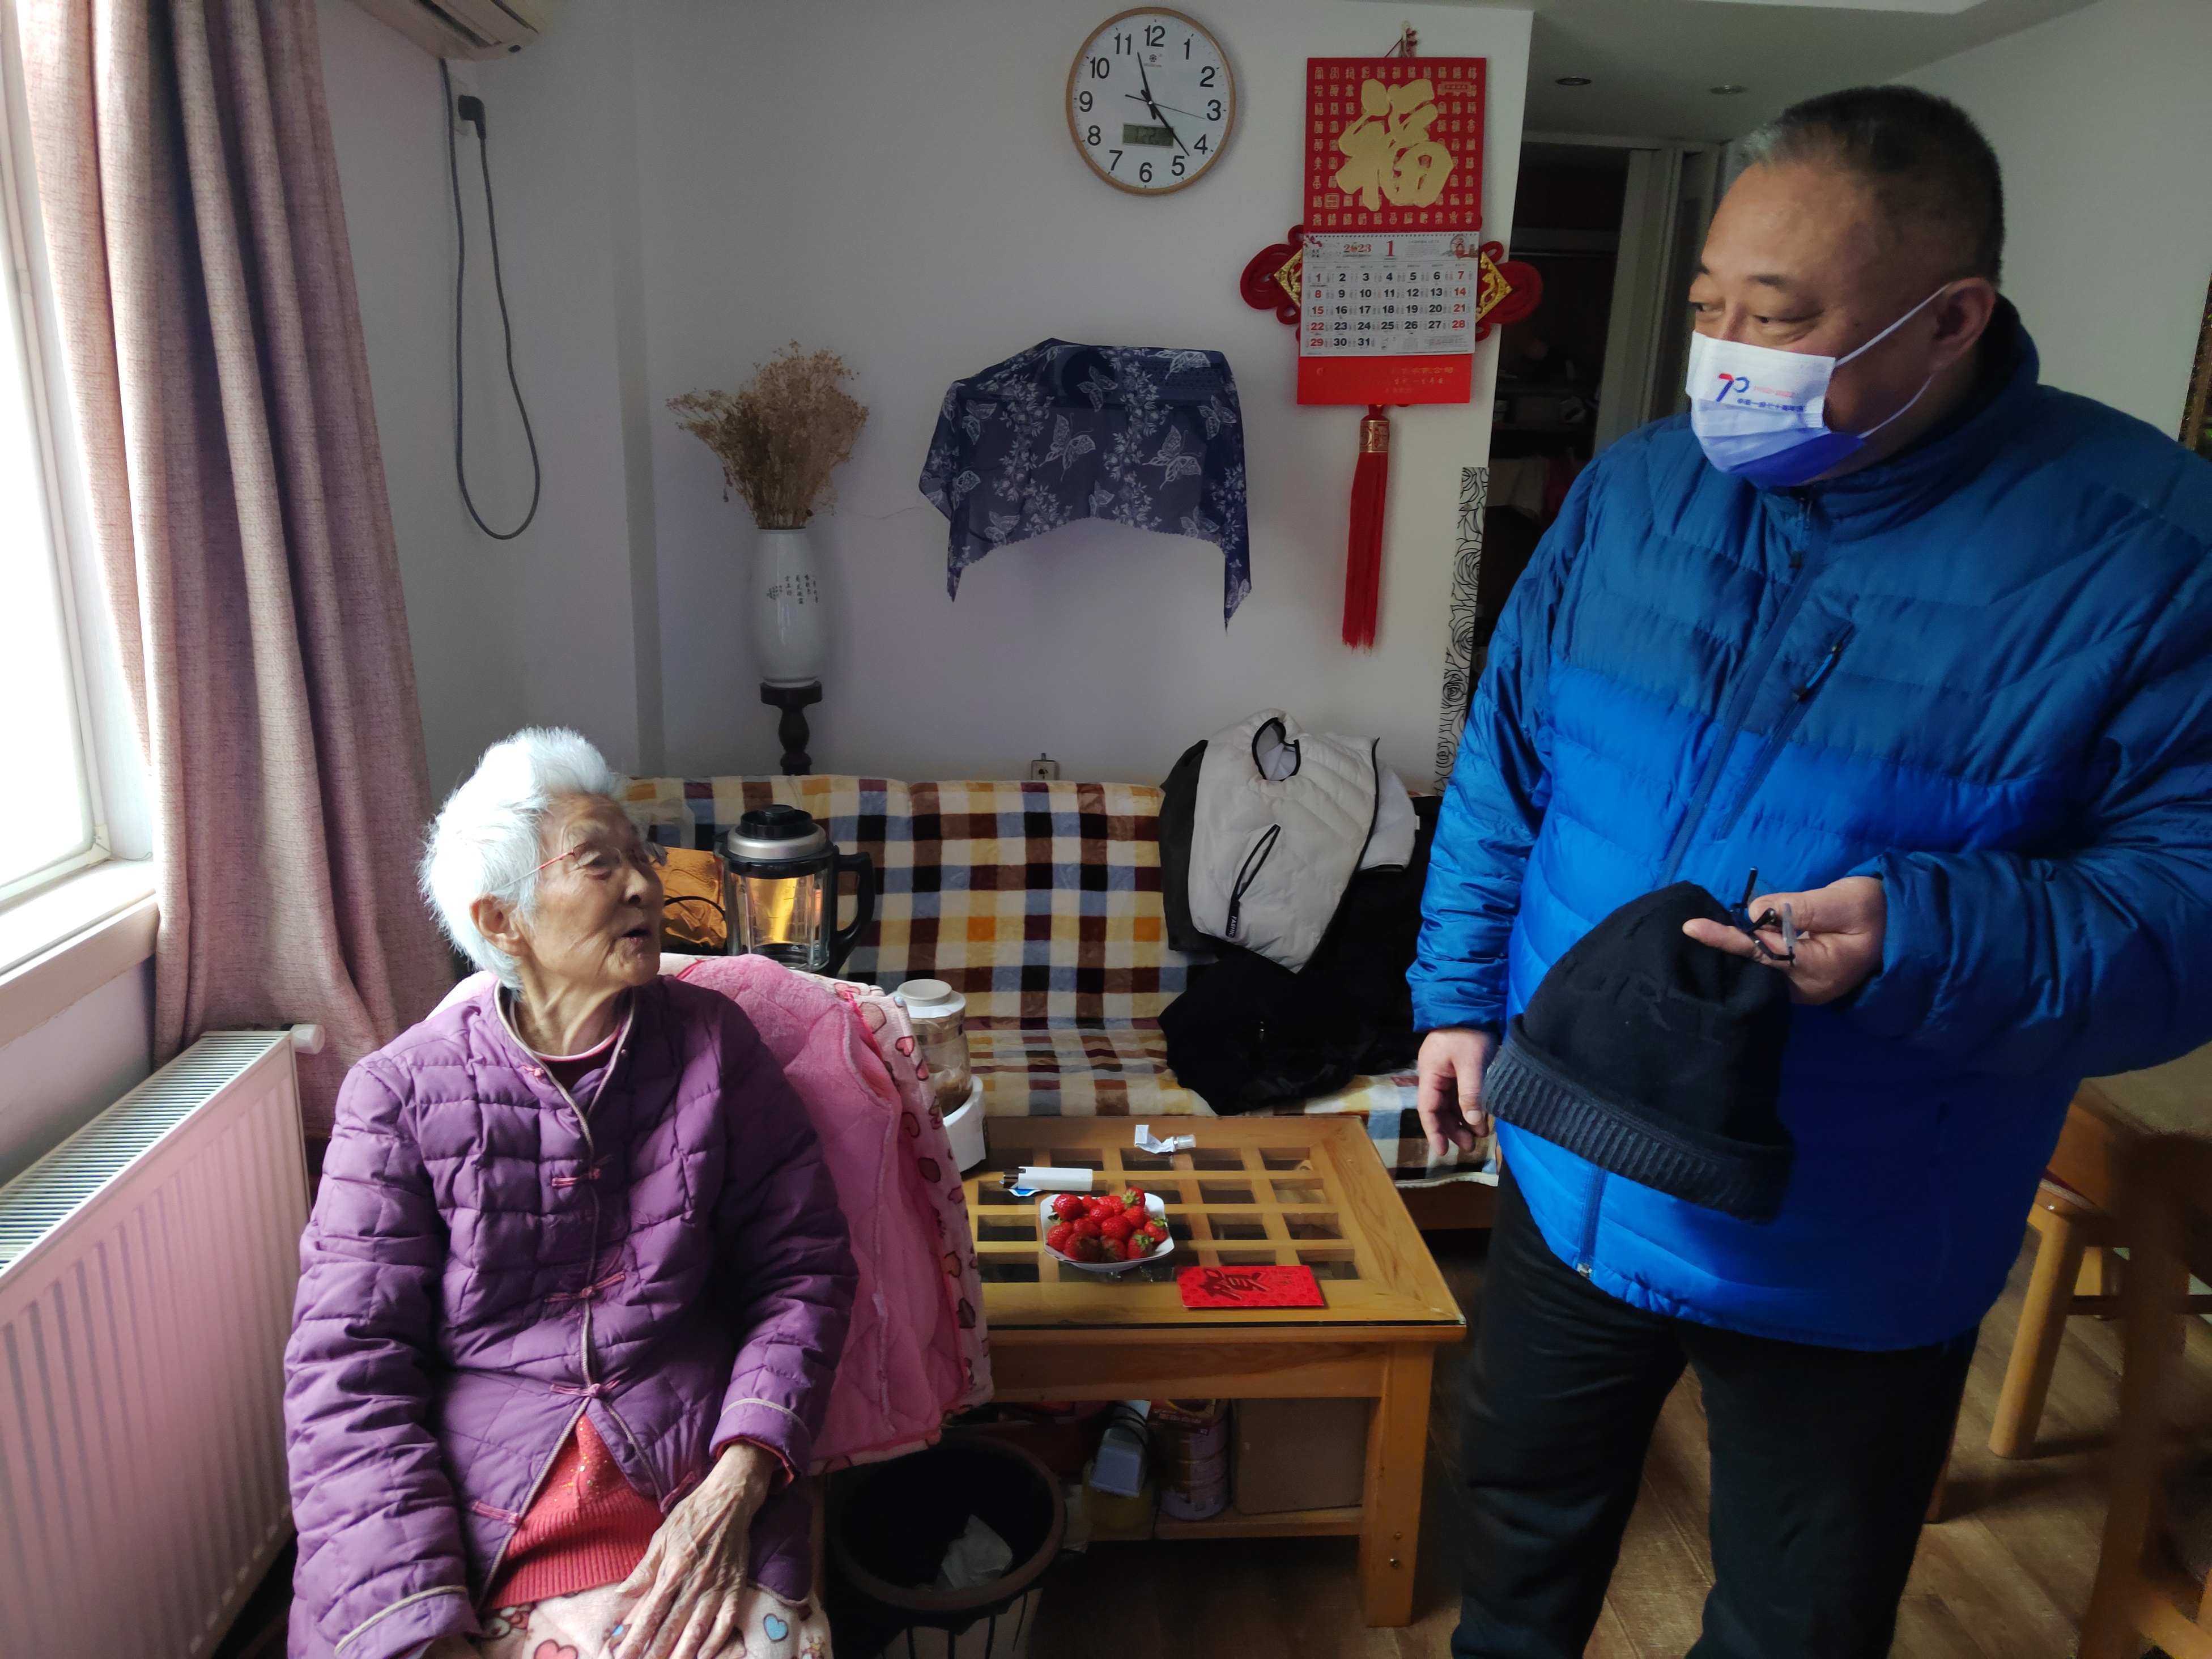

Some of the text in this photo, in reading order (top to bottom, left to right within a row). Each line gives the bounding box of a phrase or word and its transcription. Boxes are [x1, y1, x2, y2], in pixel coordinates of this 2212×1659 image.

[1114, 33, 1131, 55] 11
[1145, 25, 1165, 47] 12
[1184, 39, 1190, 59] 1
[1090, 57, 1109, 79] 10
[1200, 66, 1215, 87] 2
[1079, 91, 1092, 112] 9
[1207, 100, 1221, 121] 3
[1087, 125, 1101, 146] 8
[1194, 134, 1208, 155] 4
[1335, 78, 1453, 211] 福
[1109, 150, 1122, 171] 7
[1172, 156, 1185, 176] 5
[1139, 162, 1152, 182] 6
[1342, 243, 1372, 253] 2023
[1386, 240, 1396, 257] 1
[1316, 271, 1465, 282] 1 2 3 4 5 6 7
[1315, 287, 1466, 299] 8 9 10 11 12 13 14
[1312, 303, 1466, 314] 15 16 17 18 19 20 21
[1311, 320, 1465, 331] 22 23 24 25 26 27 28
[1310, 337, 1370, 347] 29 30 31
